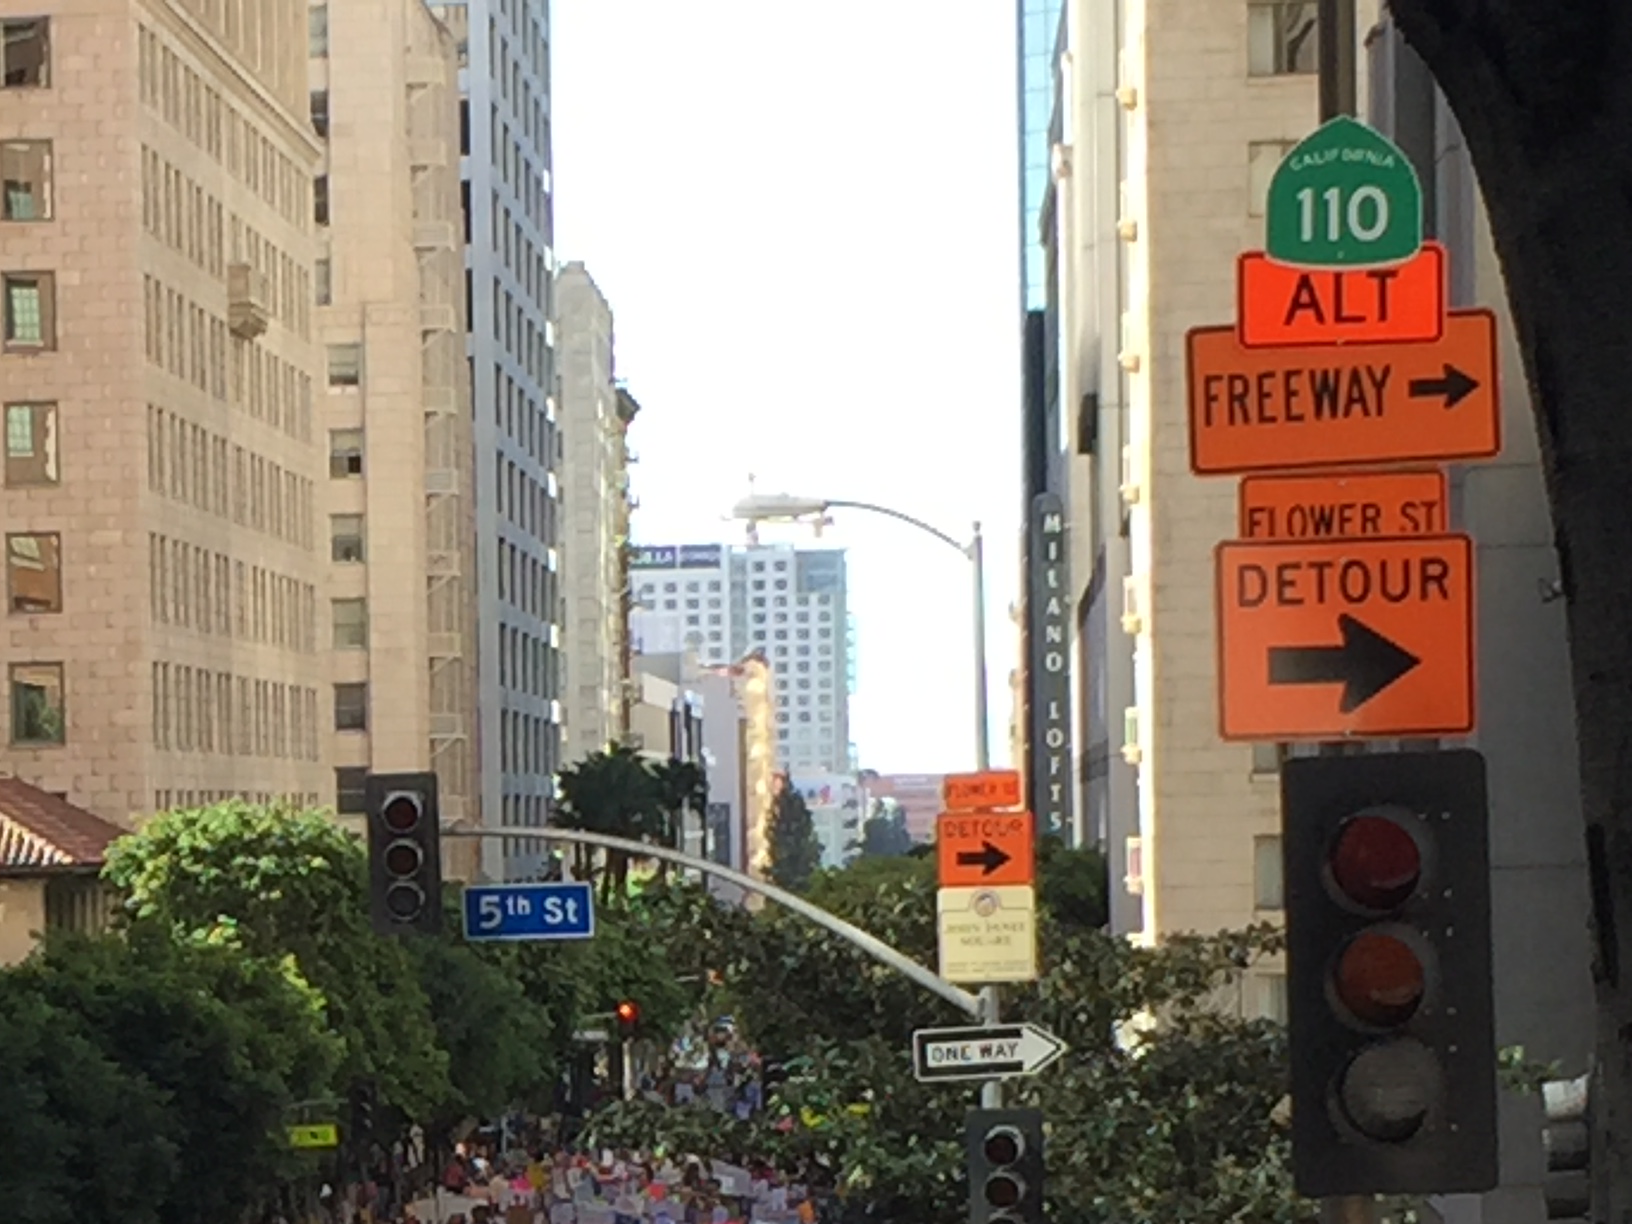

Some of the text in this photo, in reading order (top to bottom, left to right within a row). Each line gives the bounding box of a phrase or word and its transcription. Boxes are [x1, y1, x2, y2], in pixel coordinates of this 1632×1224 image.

[1289, 148, 1395, 171] CALIFORNIA
[1296, 185, 1389, 243] 110
[1283, 268, 1399, 326] ALT
[1204, 364, 1391, 428] FREEWAY
[1248, 501, 1438, 538] FLOWER ST
[1043, 512, 1064, 672] MILANO
[1237, 557, 1449, 608] DETOUR
[944, 819, 1023, 838] DETOUR
[479, 894, 578, 929] 5th St
[931, 1042, 1019, 1063] ONE WAY
